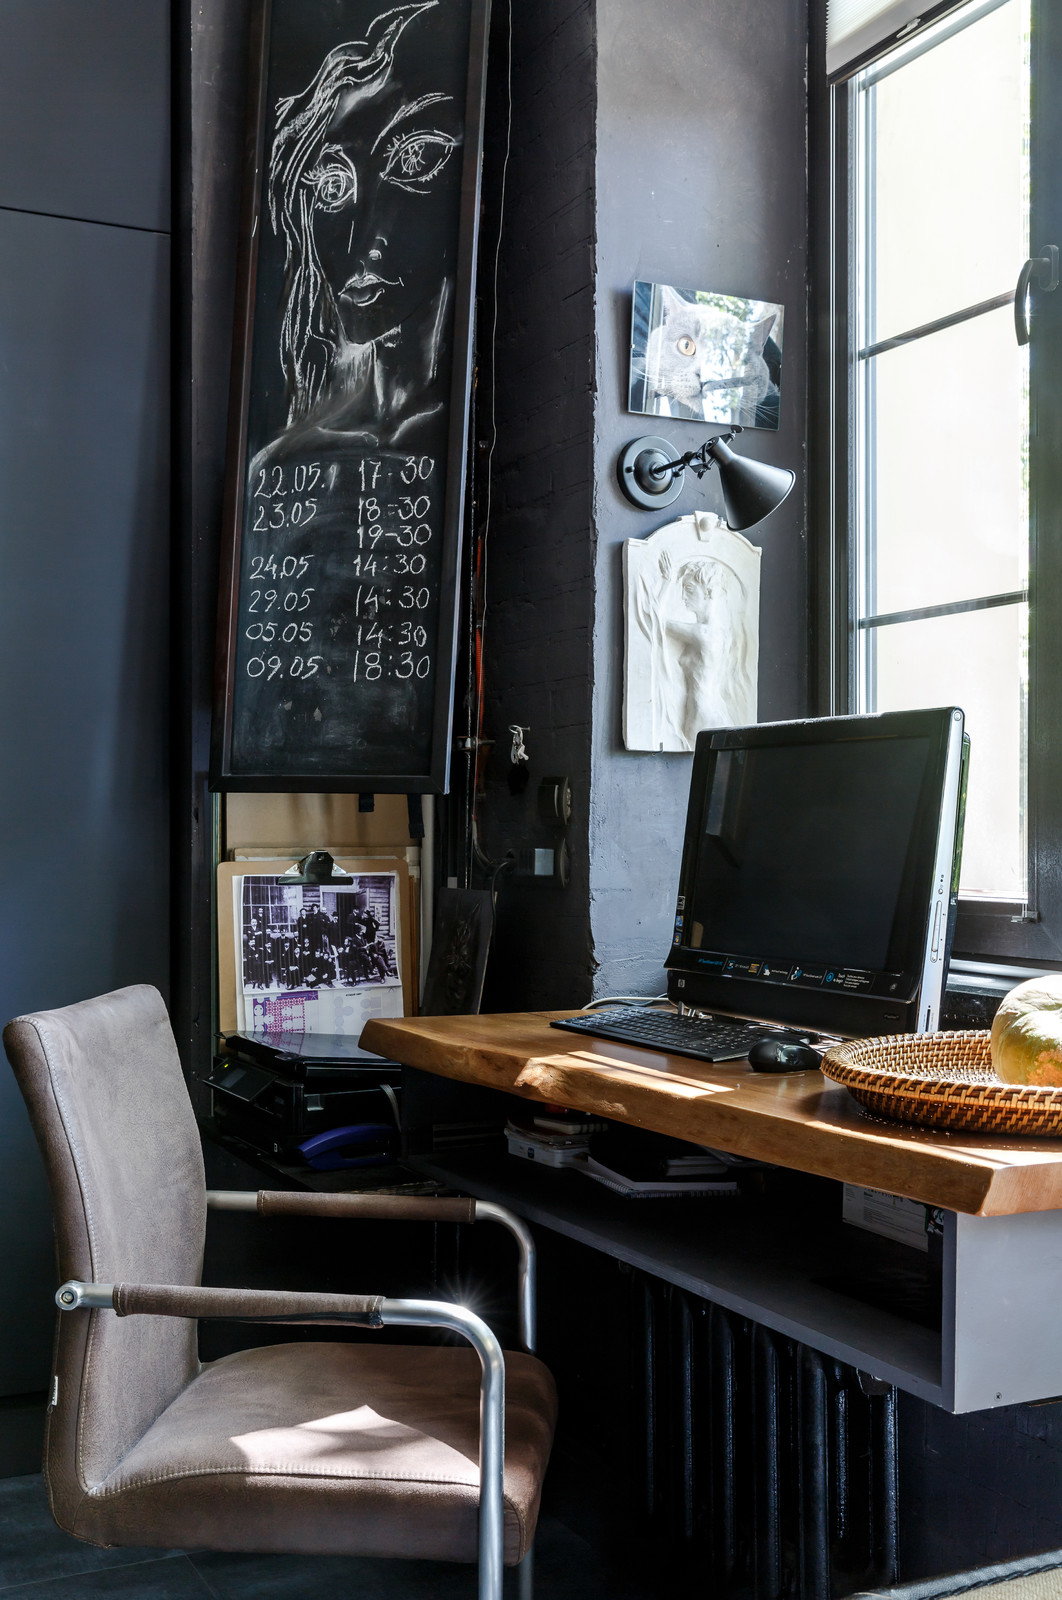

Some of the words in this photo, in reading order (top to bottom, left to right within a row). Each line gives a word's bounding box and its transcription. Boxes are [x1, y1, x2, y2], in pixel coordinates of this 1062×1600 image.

[252, 498, 318, 531] 23.05
[357, 523, 432, 549] 19-30
[353, 554, 427, 577] 14:30
[248, 588, 315, 613] 29.05
[355, 585, 430, 616] 14:30
[245, 622, 314, 642] 05.05
[357, 621, 427, 648] 14:30
[246, 655, 323, 681] 09.05
[353, 650, 430, 682] 18:30
